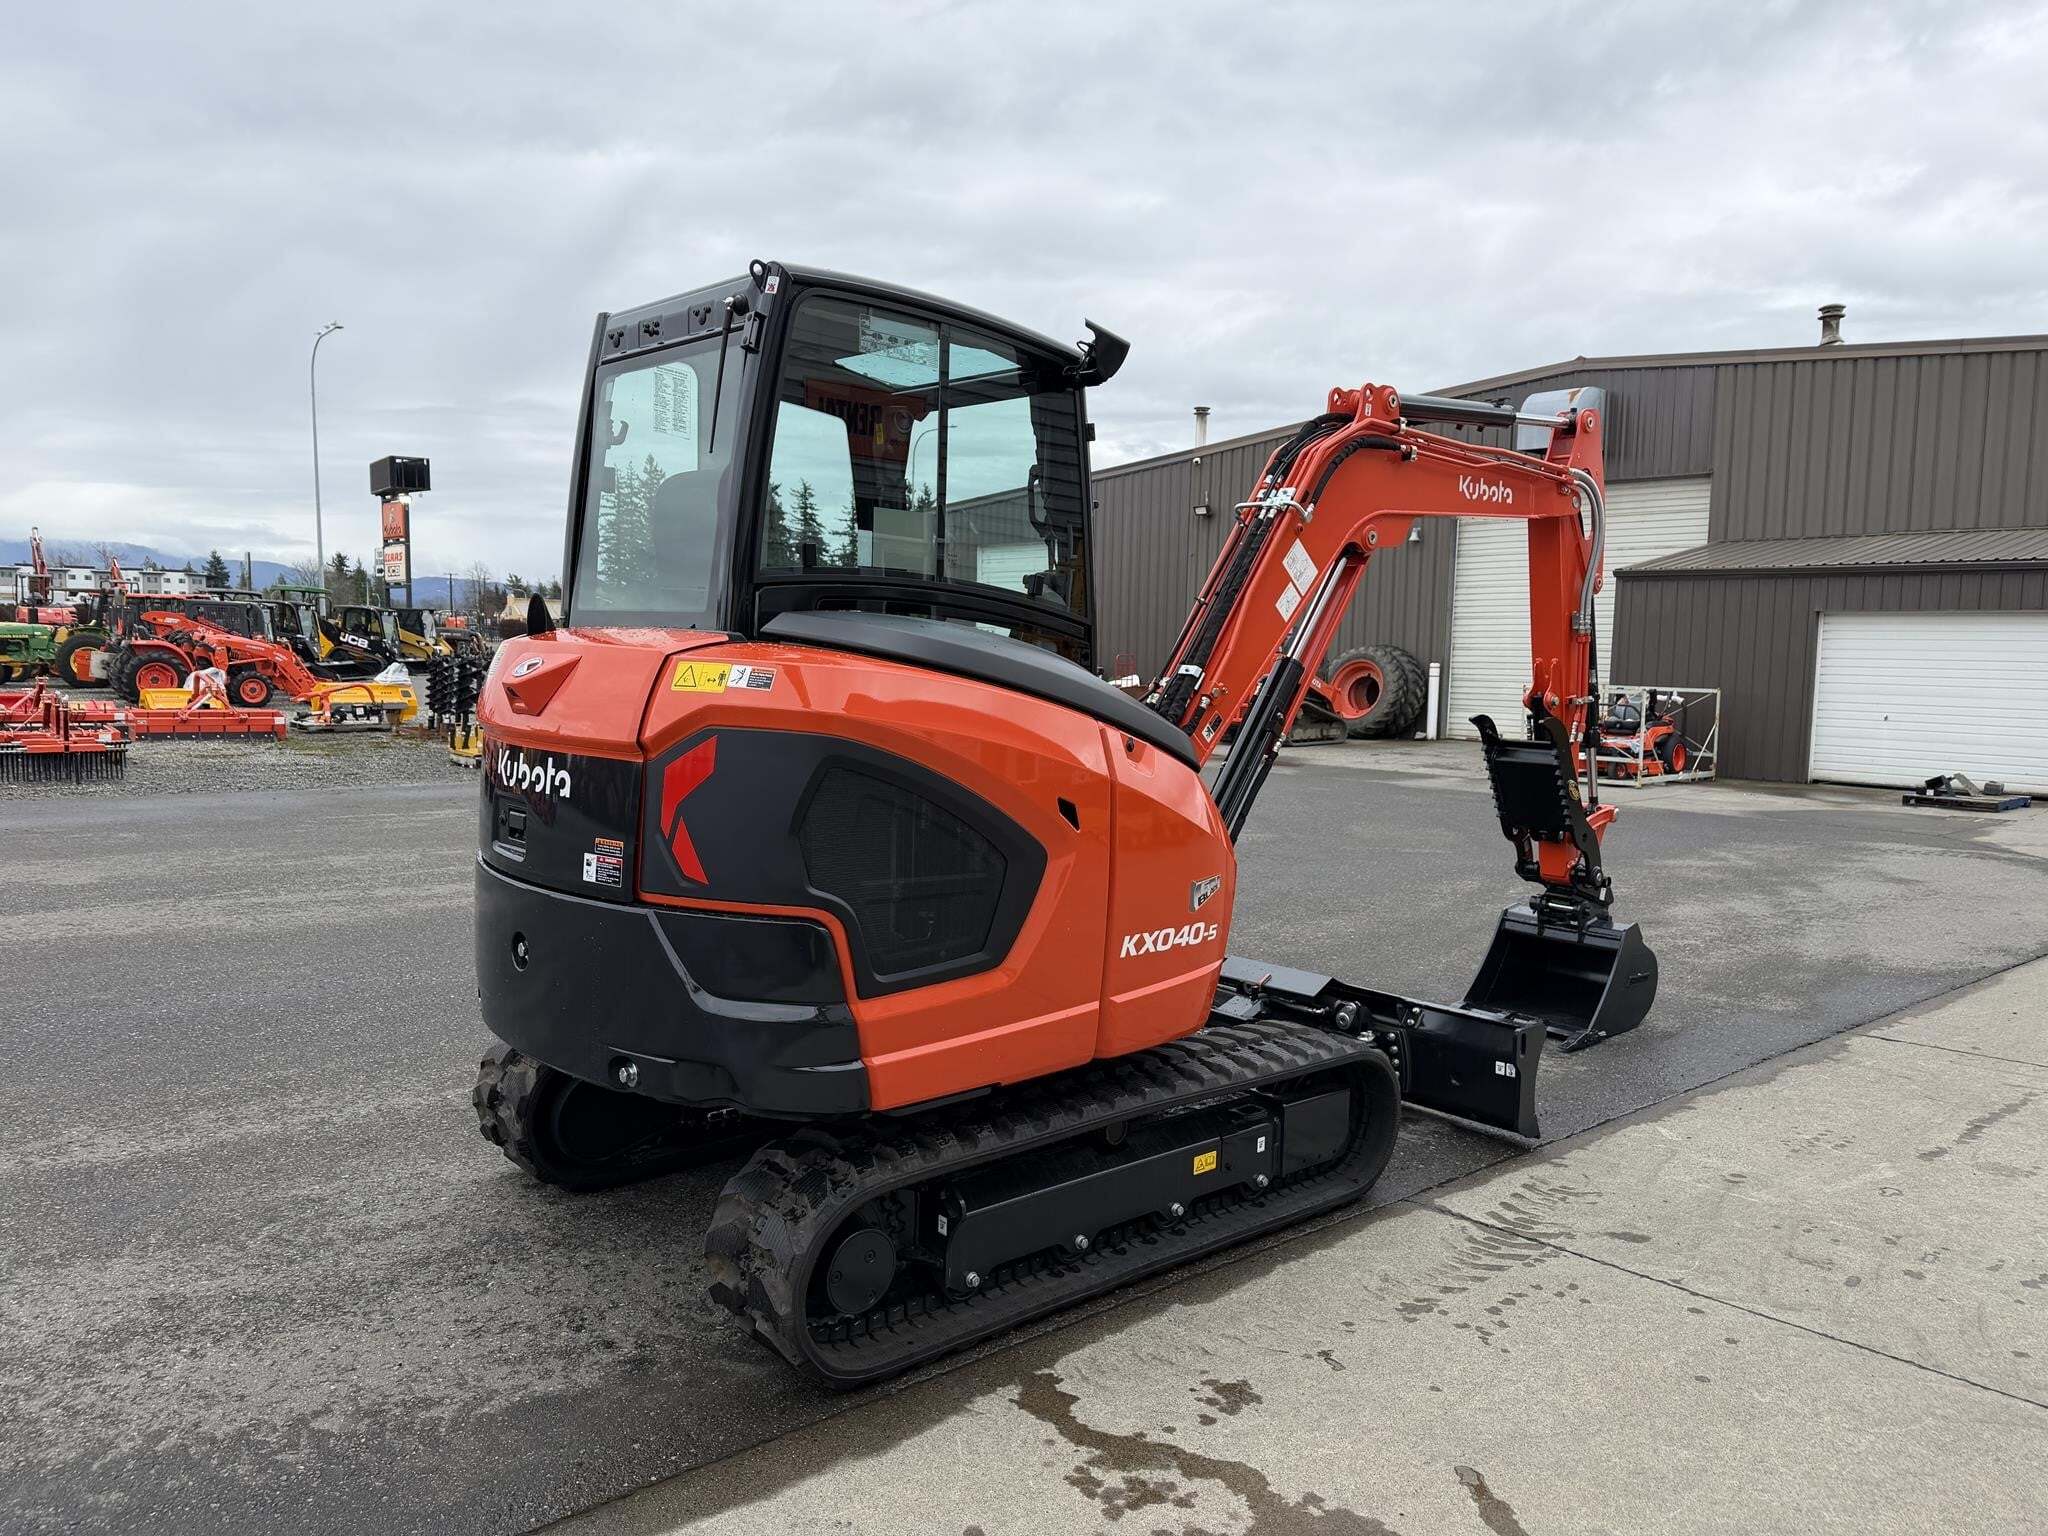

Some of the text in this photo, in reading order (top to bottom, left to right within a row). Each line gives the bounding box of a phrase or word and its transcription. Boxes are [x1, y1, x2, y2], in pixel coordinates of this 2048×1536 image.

[1458, 474, 1513, 505] Kubota
[339, 631, 369, 649] JCB
[497, 748, 572, 799] Kubota
[1119, 921, 1218, 959] KX040-5
